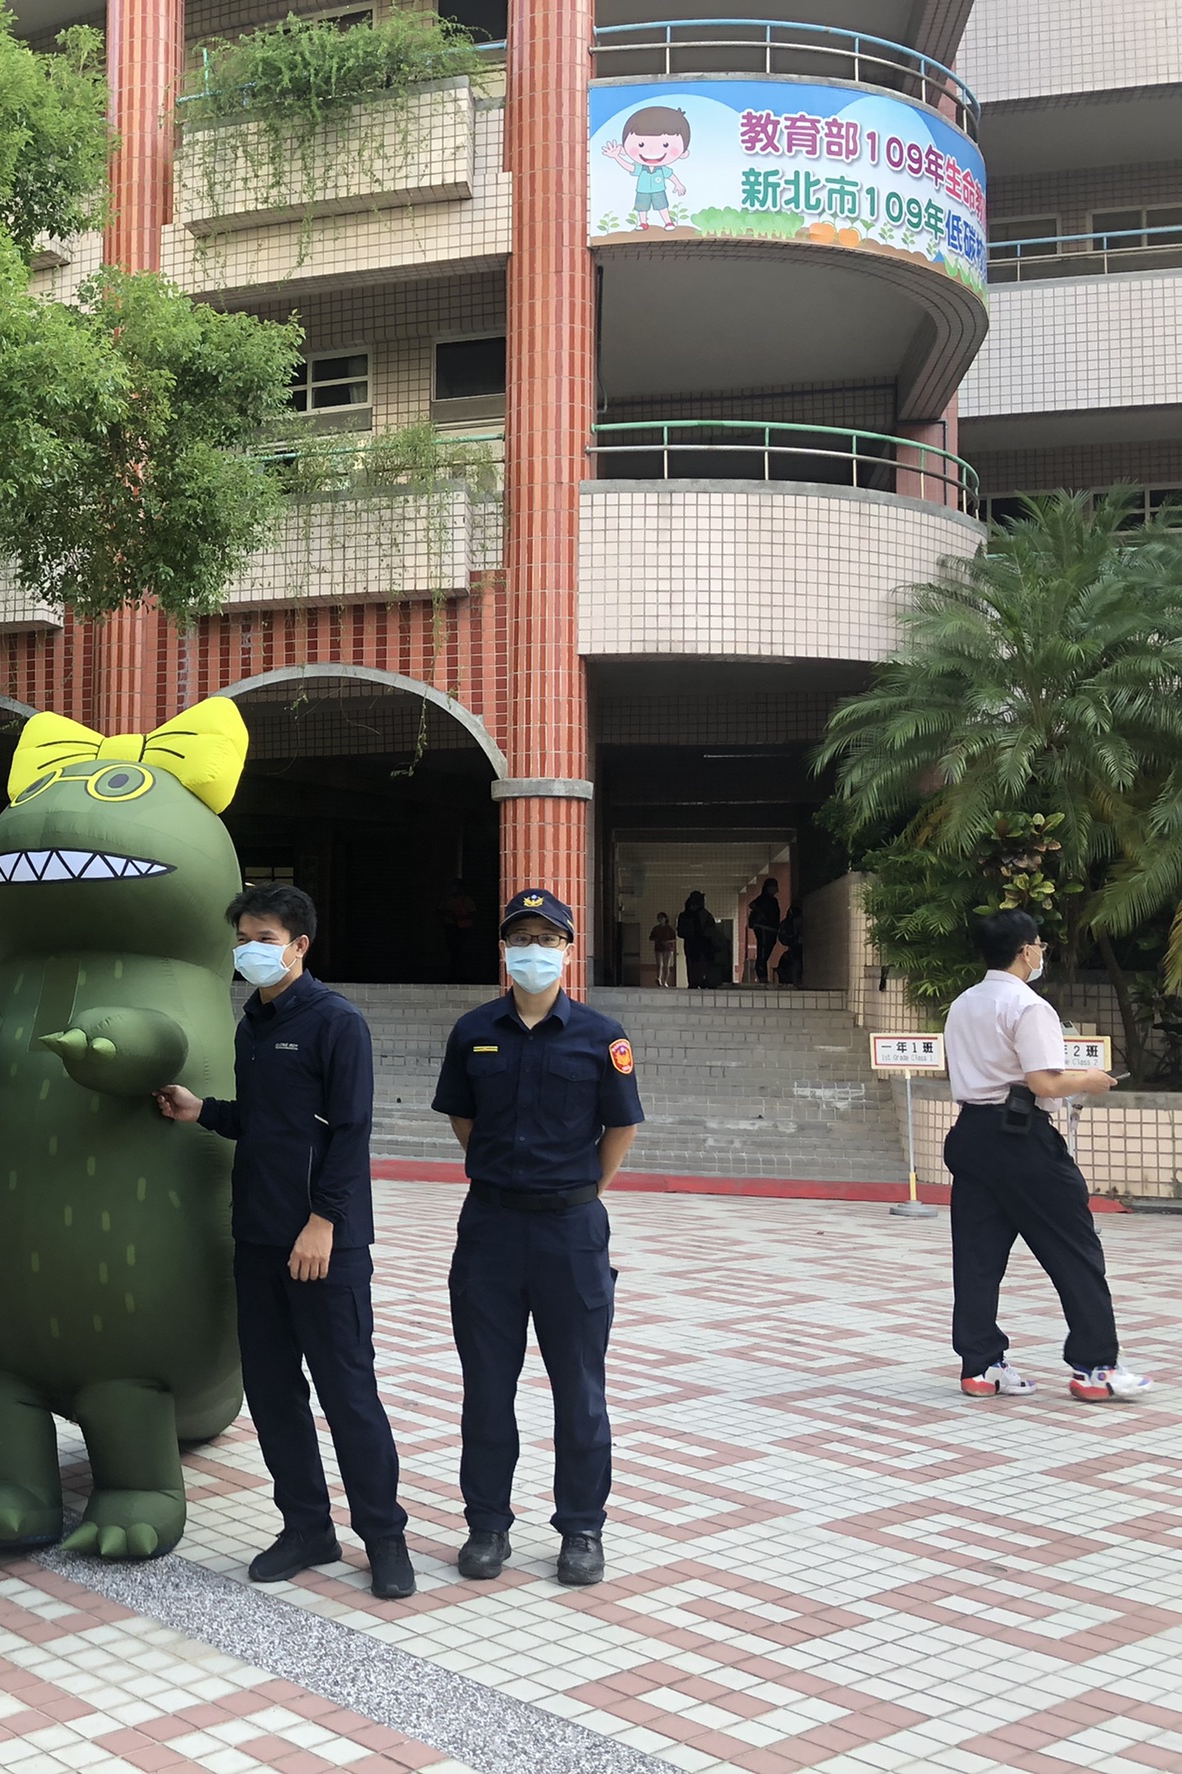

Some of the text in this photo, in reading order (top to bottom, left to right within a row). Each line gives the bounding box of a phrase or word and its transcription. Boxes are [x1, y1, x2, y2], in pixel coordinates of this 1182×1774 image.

[881, 1041, 934, 1054] 一年1班
[893, 1054, 909, 1062] Grade
[911, 1054, 927, 1062] Class
[1072, 1058, 1091, 1066] Class
